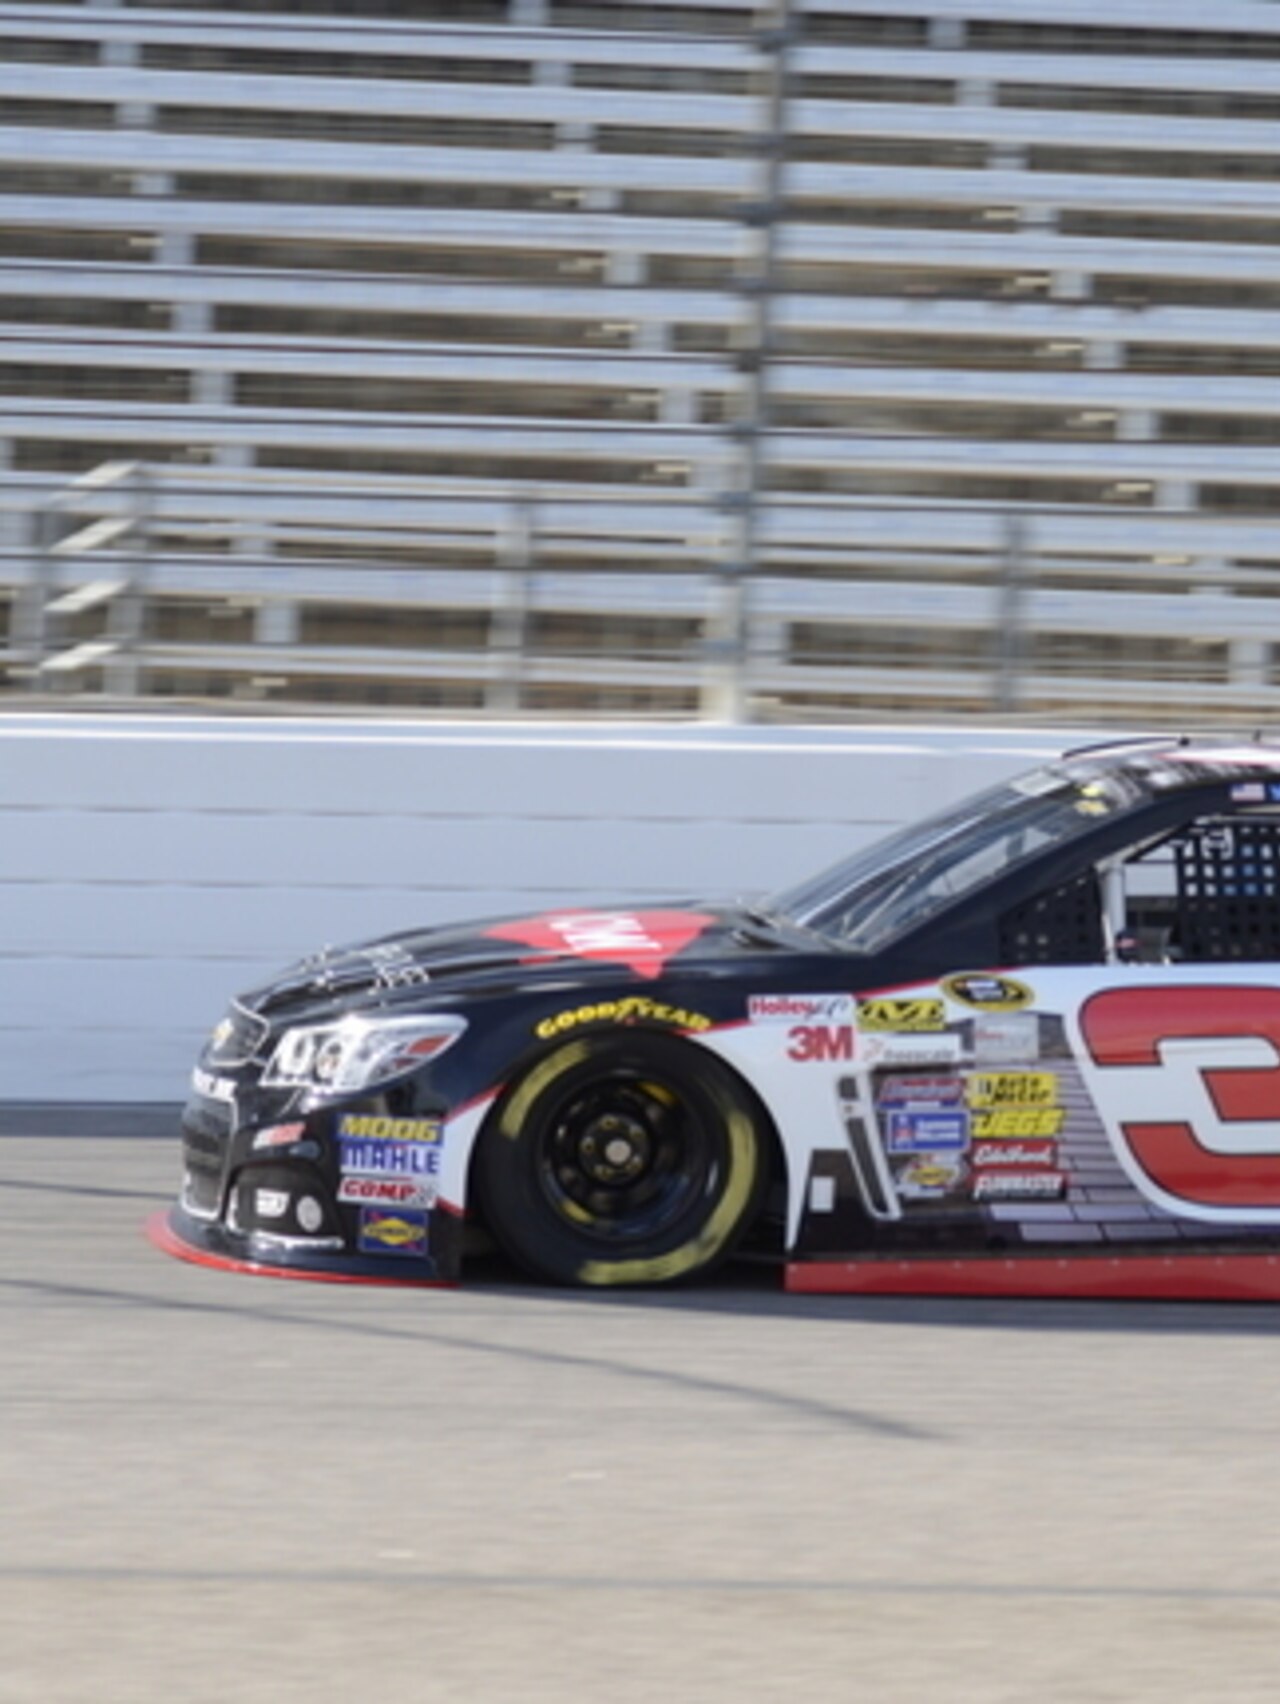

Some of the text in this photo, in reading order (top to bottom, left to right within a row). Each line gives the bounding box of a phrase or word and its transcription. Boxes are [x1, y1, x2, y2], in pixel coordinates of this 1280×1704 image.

[536, 997, 712, 1039] GOODYEAR
[787, 1026, 853, 1062] 3M
[341, 1115, 440, 1142] MOOG
[342, 1145, 440, 1174] MAHLE
